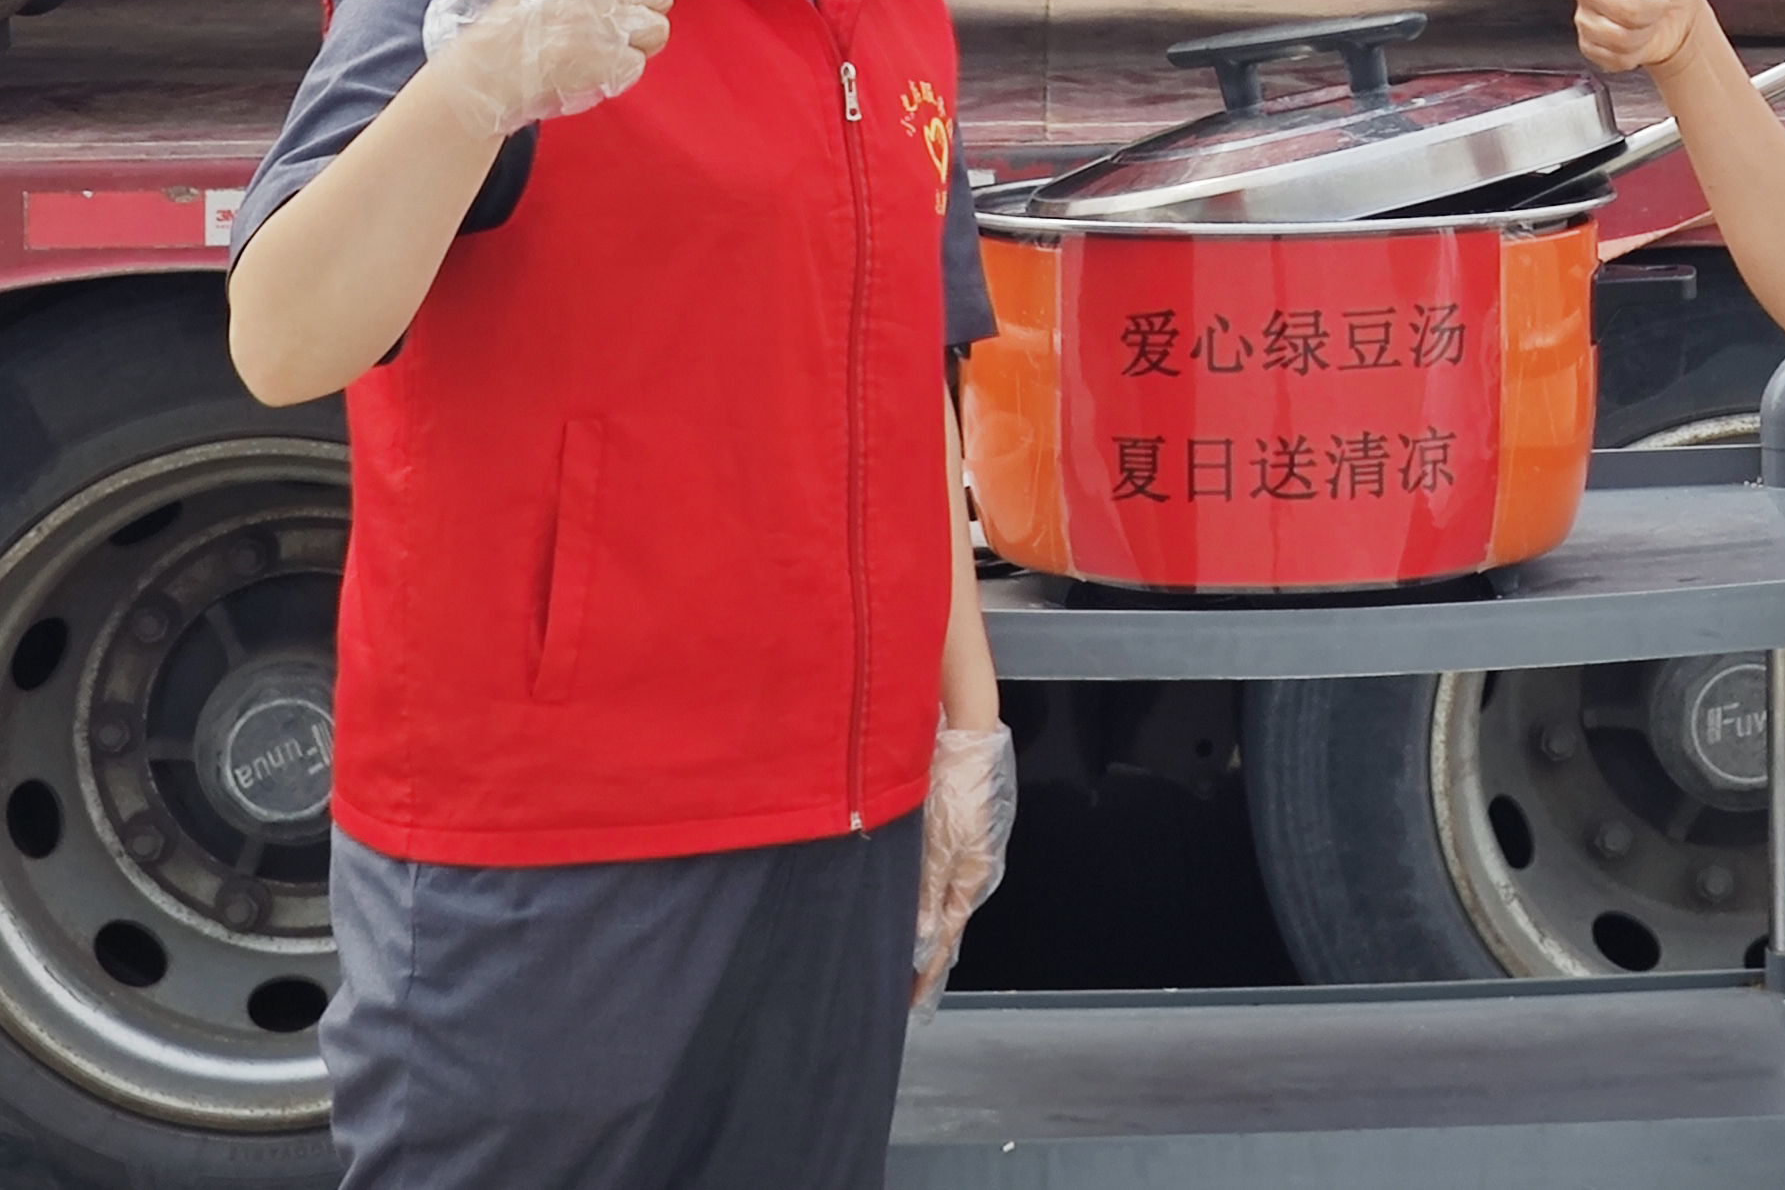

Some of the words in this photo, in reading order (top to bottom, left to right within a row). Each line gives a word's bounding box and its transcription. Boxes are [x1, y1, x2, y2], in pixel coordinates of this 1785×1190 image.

[1119, 301, 1467, 378] 爱心绿豆汤
[1110, 424, 1457, 504] 夏日送清凉
